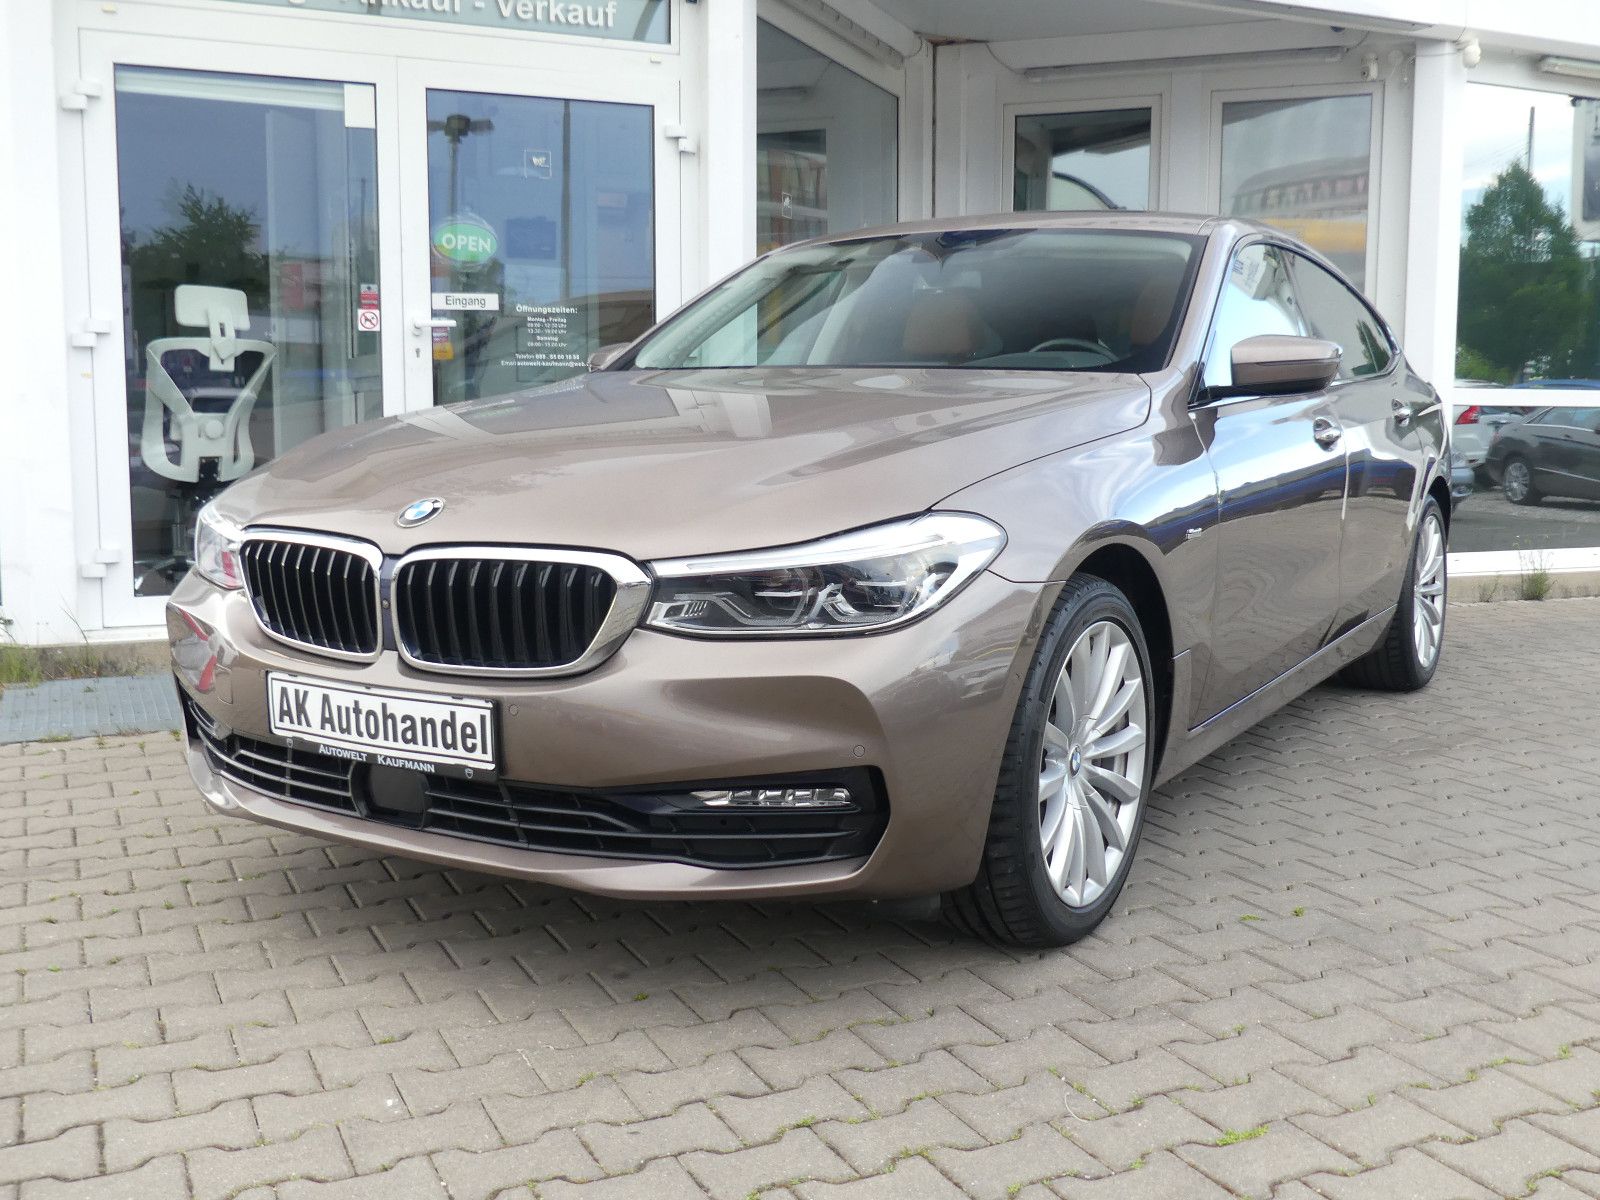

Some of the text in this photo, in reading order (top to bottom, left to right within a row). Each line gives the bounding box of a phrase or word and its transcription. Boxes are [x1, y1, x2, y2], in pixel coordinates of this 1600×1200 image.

[498, 0, 617, 27] Verkauf
[442, 233, 492, 254] OPEN
[445, 295, 486, 308] Eingang
[516, 304, 578, 315] Öffnungszeiten:
[279, 686, 489, 755] AK Autohandel
[318, 744, 435, 774] AUTOWELT KAUFMANN
